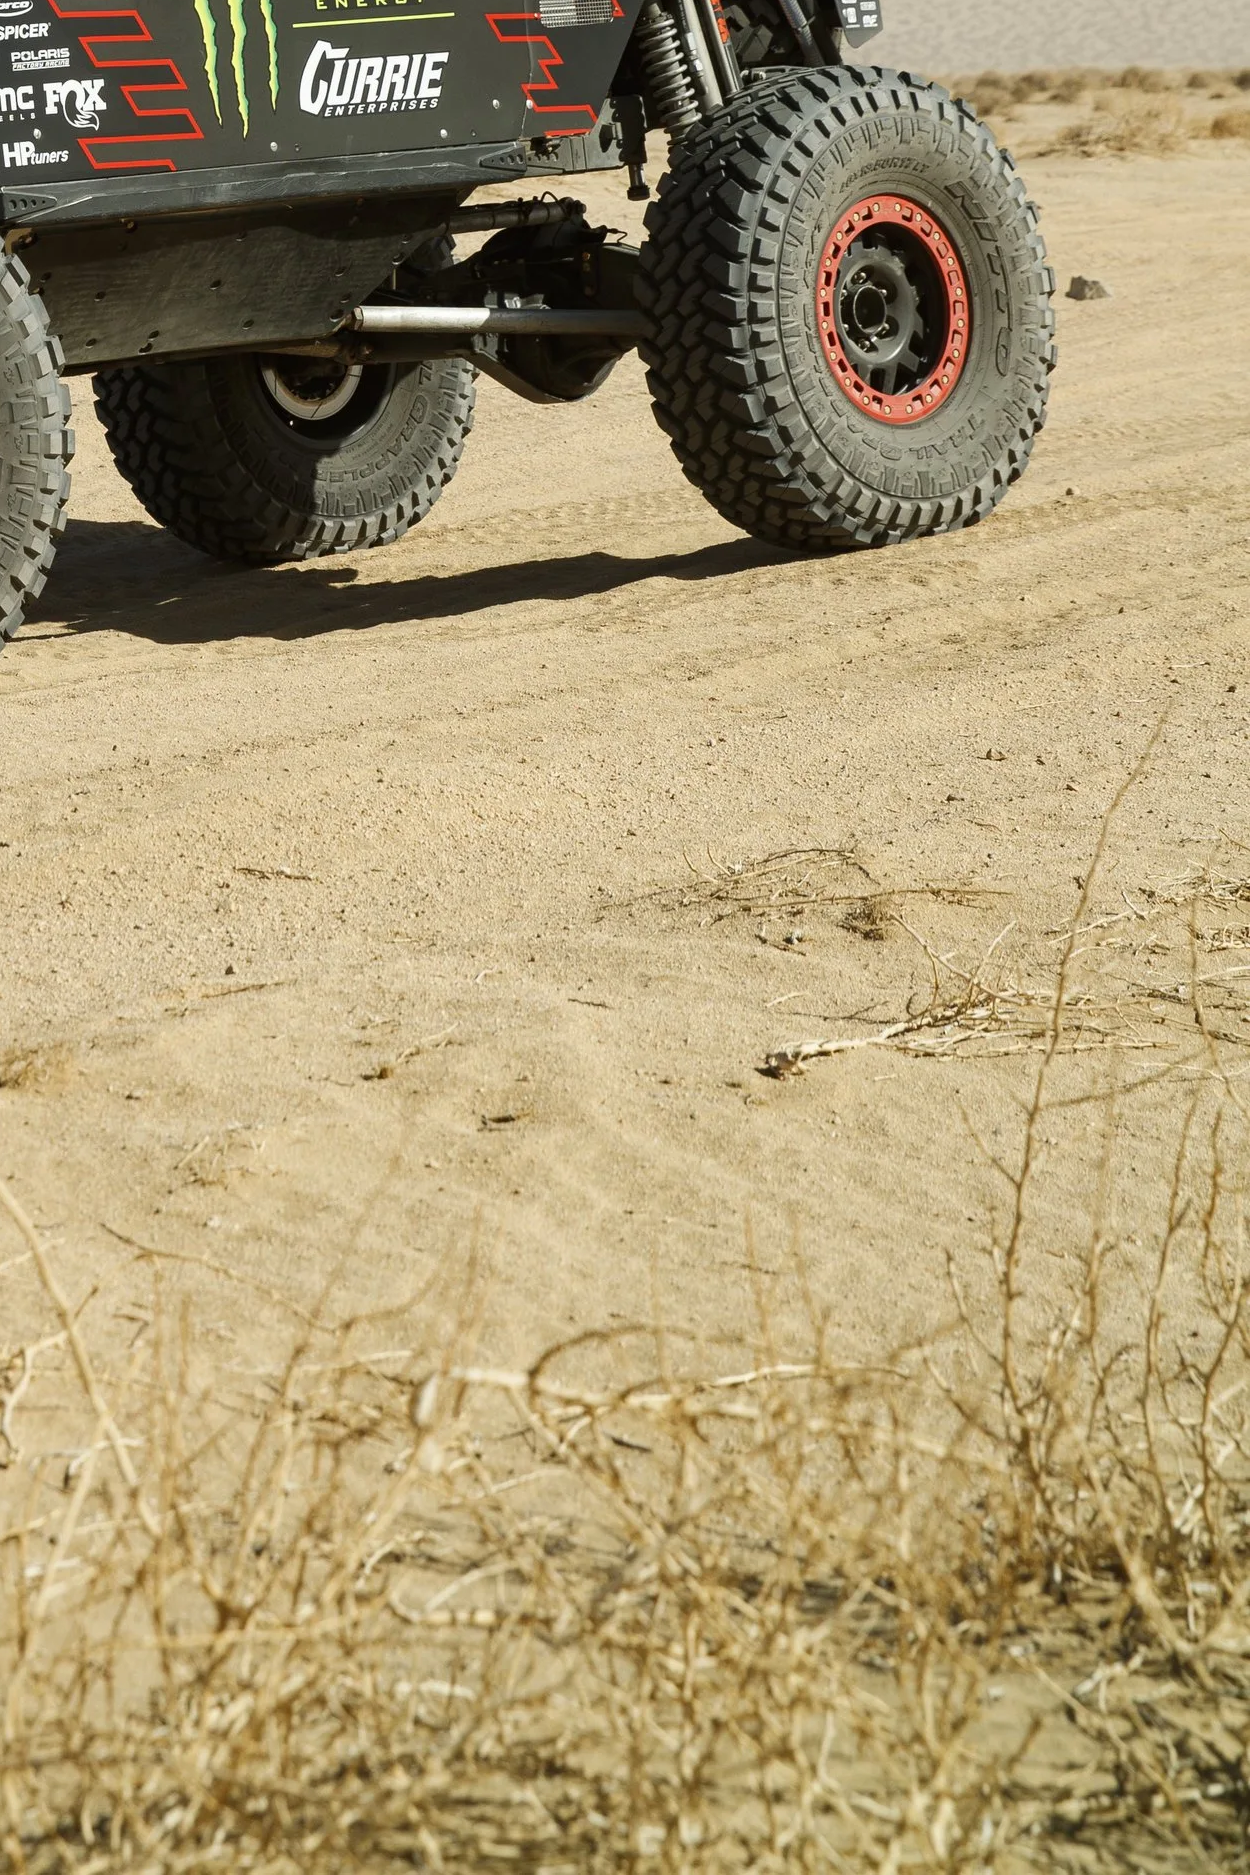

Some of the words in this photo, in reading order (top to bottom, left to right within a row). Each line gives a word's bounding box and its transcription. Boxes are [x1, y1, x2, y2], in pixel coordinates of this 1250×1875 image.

[11, 47, 70, 62] POLARIS
[299, 39, 450, 115] CURRIE
[43, 79, 107, 130] FOX
[324, 98, 439, 117] ENTERPRISES
